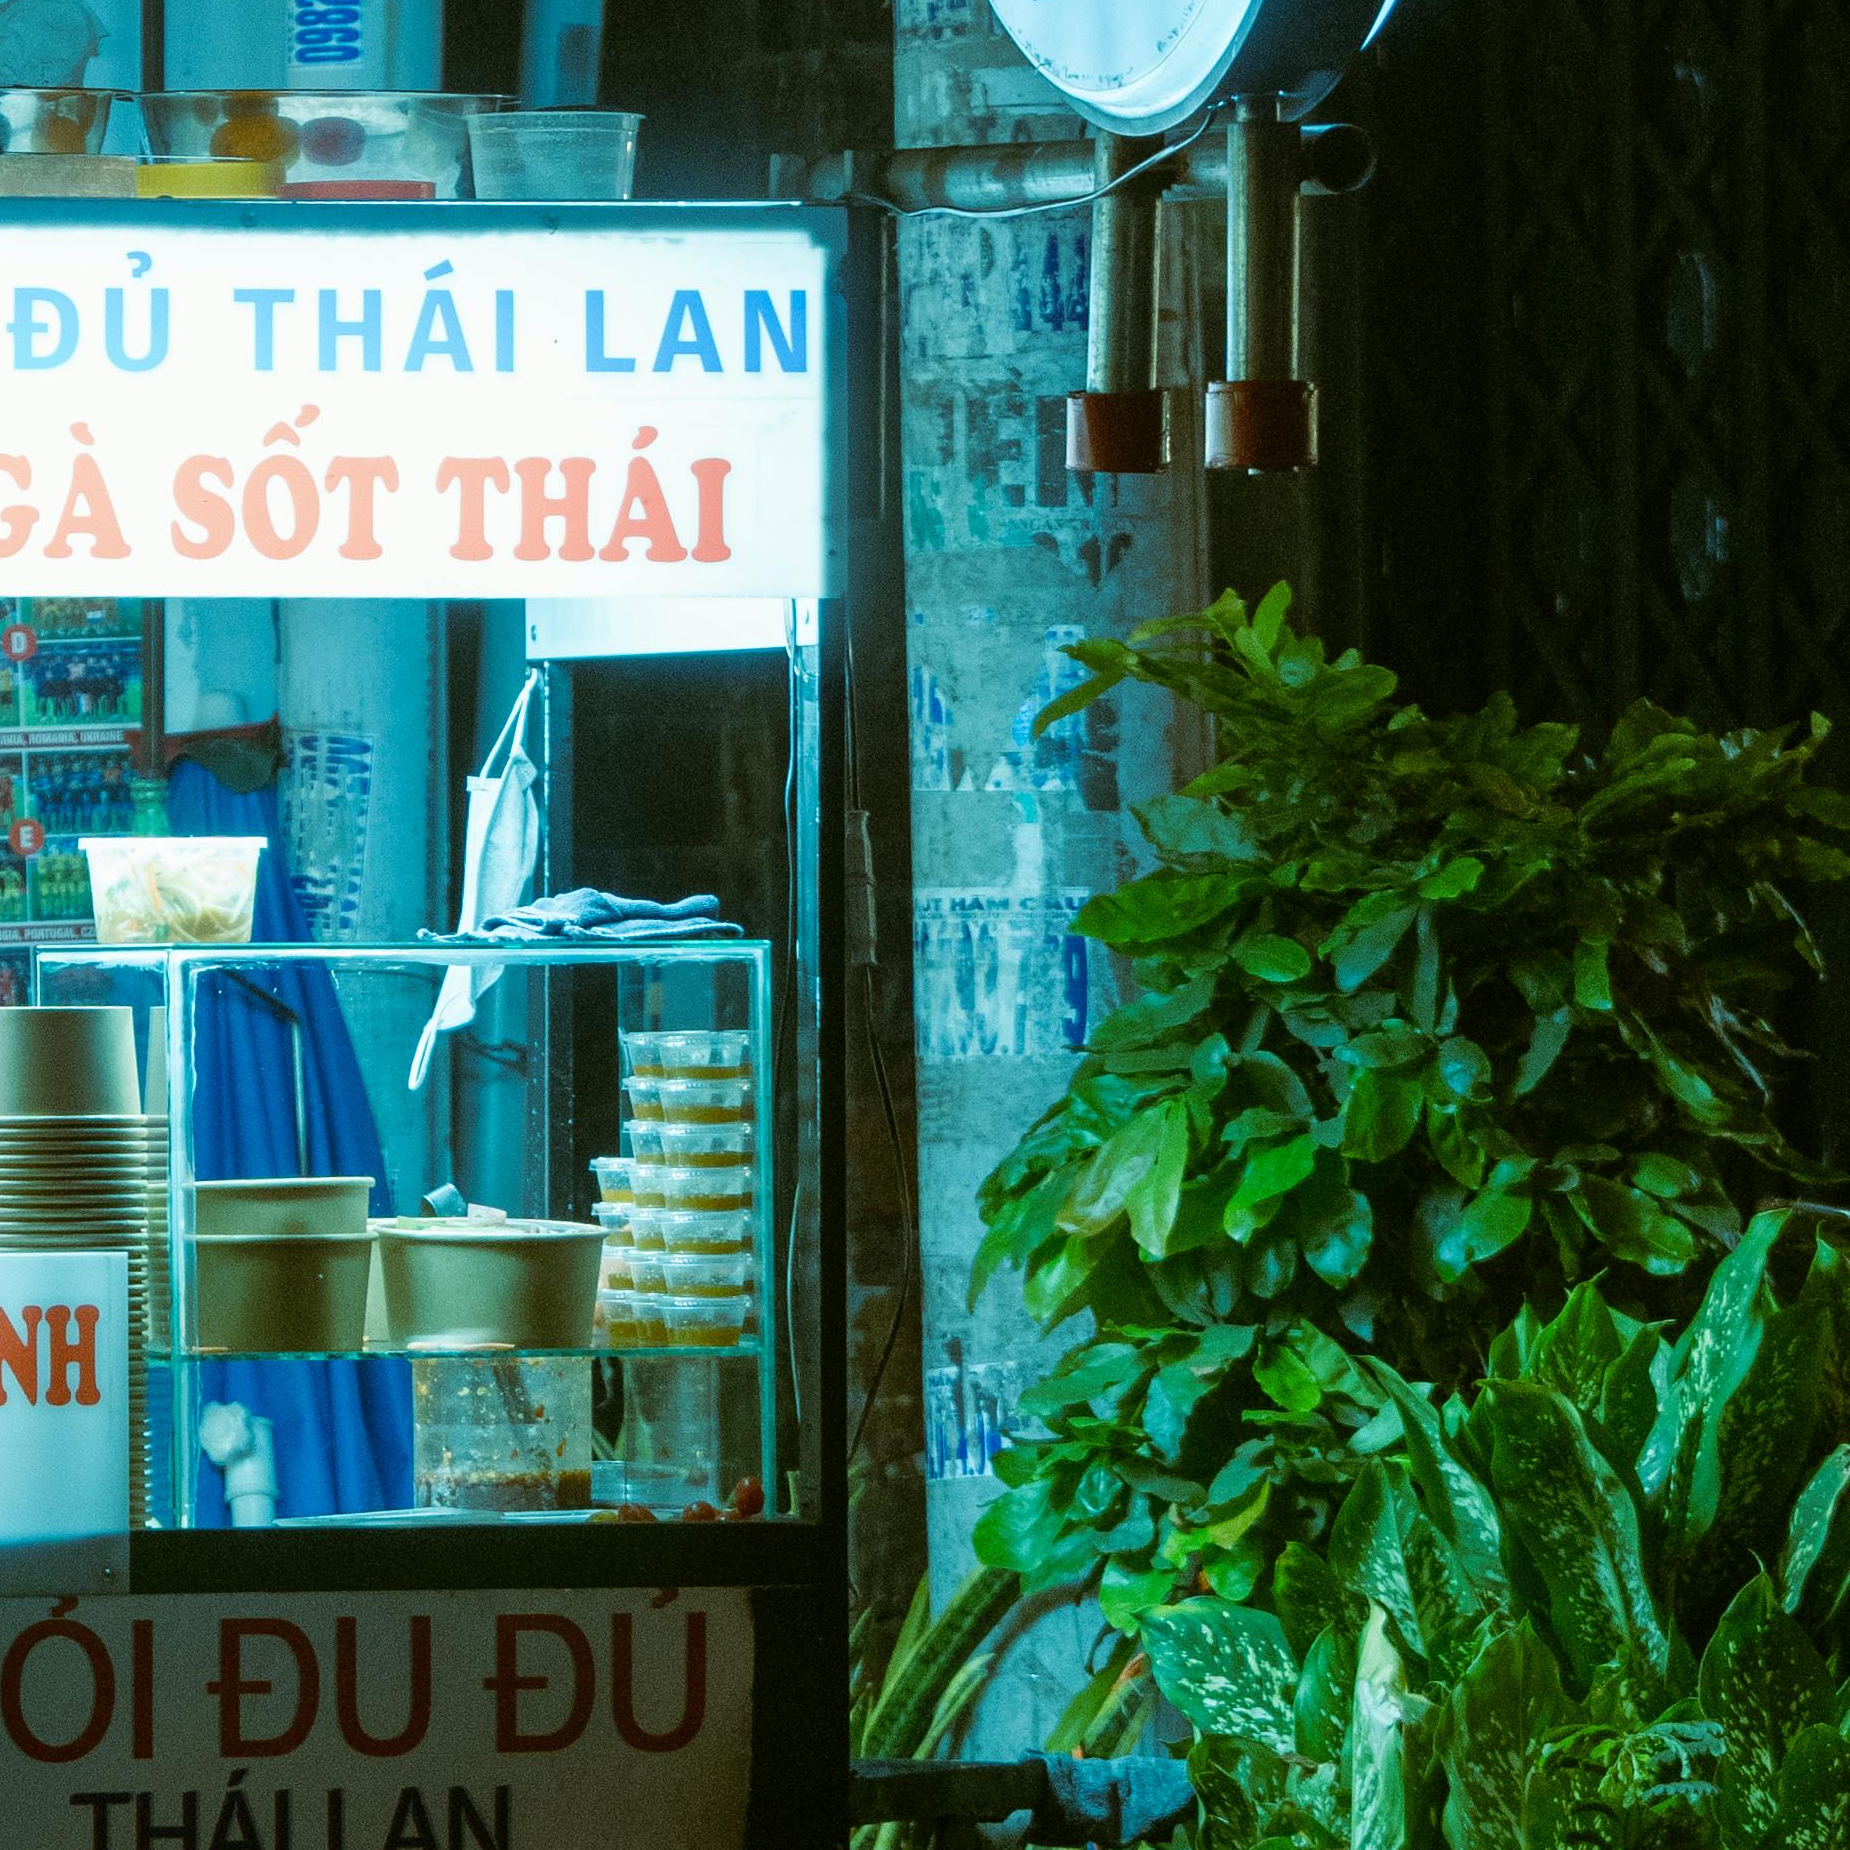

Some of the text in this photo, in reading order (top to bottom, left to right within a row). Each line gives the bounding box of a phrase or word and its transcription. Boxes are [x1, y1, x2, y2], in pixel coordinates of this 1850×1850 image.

[7, 251, 170, 372] ĐỦ
[234, 258, 516, 372] THÁI
[586, 288, 807, 373] LAN
[171, 404, 399, 561] SỐT
[435, 425, 732, 563] THÁI
[206, 1616, 432, 1758] ĐU
[484, 1588, 707, 1754] ĐỦ
